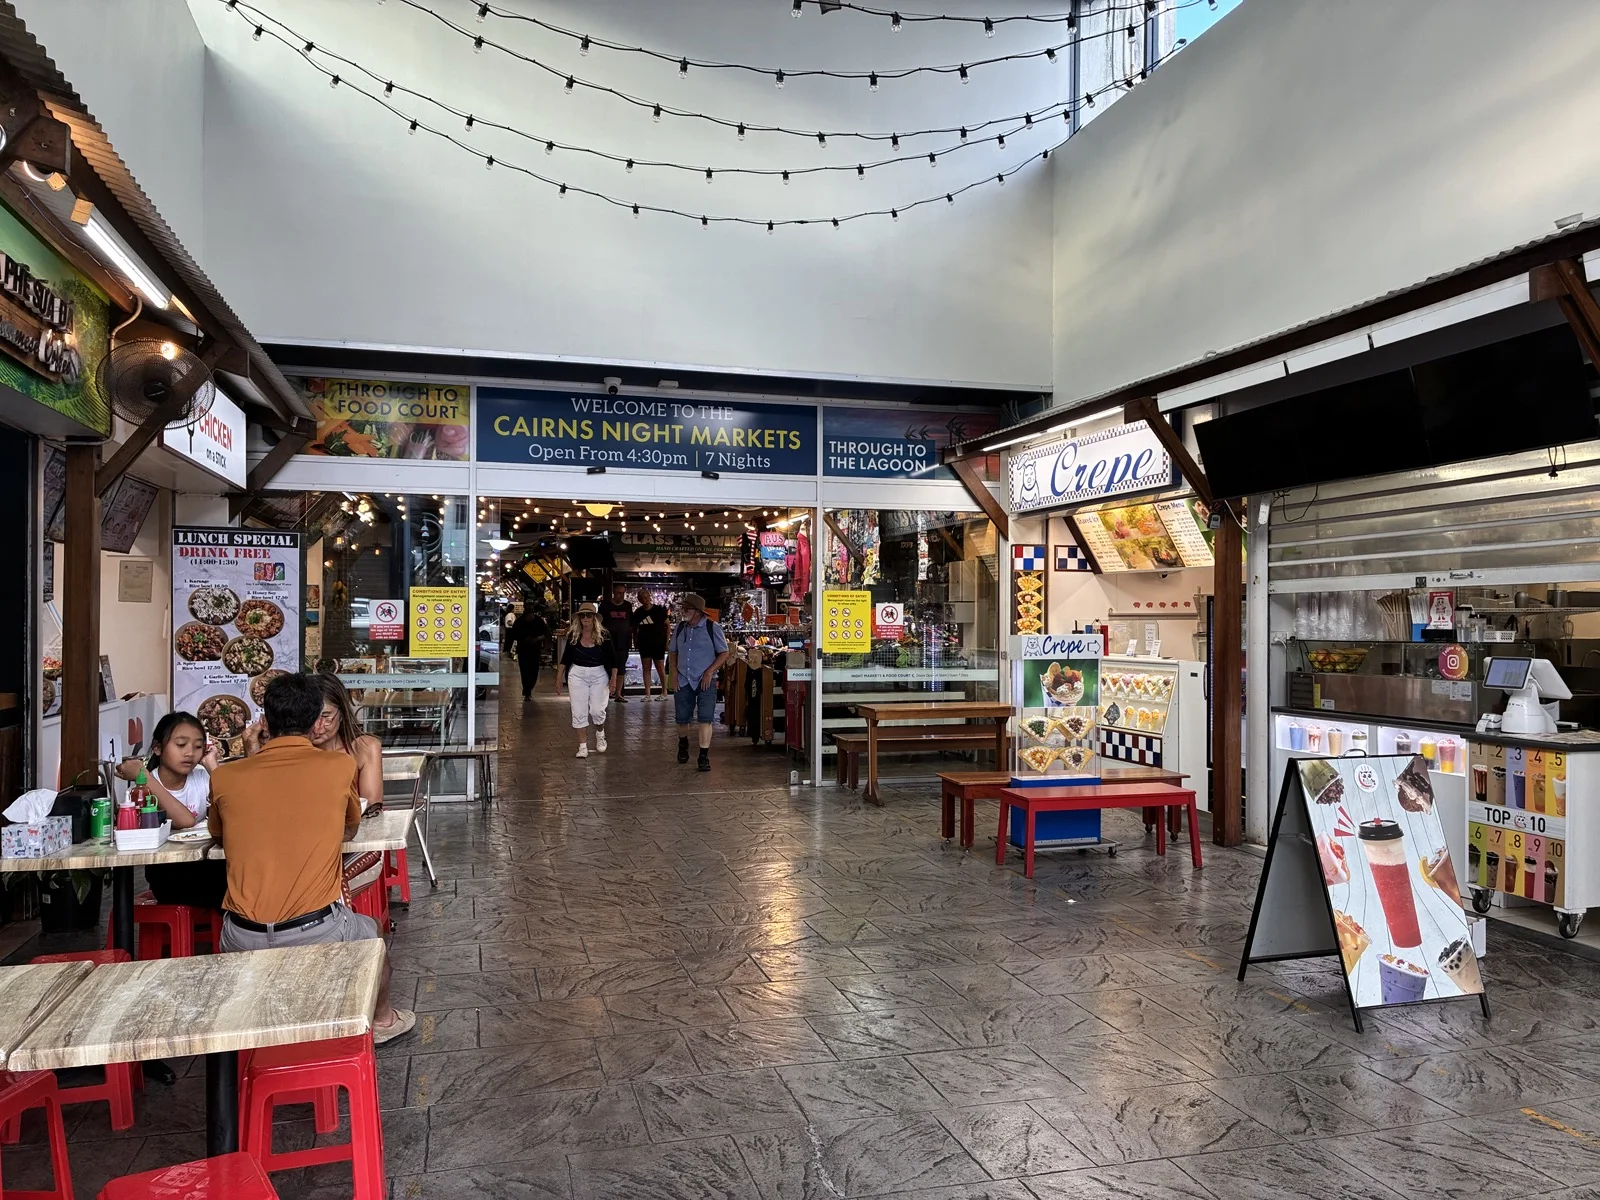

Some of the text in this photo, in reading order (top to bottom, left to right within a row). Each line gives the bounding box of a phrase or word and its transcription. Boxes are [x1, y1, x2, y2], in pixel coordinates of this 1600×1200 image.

[336, 382, 458, 402] THROUGH TO
[338, 400, 458, 419] FOOD COURT
[571, 398, 734, 420] WELCOME TO THE
[199, 405, 232, 452] CHICKEN
[494, 416, 801, 450] CAIRNS NIGHT MARKETS
[829, 441, 926, 458] THROUGH TO
[528, 444, 770, 470] Open From 4:30pm 7 Nights
[829, 456, 926, 473] THE LAGOON
[1050, 442, 1157, 497] Crepe
[1157, 502, 1172, 511] Crepe
[178, 532, 293, 546] LUNCH SPECIAL
[620, 534, 674, 546] GLASS
[180, 546, 270, 559] DRINK FREE
[1042, 636, 1086, 660] Crepe
[1478, 743, 1482, 755] 1
[1496, 745, 1502, 758] 2
[1514, 747, 1522, 760] 3
[1534, 750, 1542, 764] 4
[1555, 752, 1562, 766] 5
[1484, 807, 1546, 833] TOP 10
[1475, 826, 1481, 839] 6
[1495, 830, 1502, 843] 7
[1514, 834, 1521, 848] 8
[1534, 839, 1541, 852] 9
[1550, 842, 1562, 857] 10
